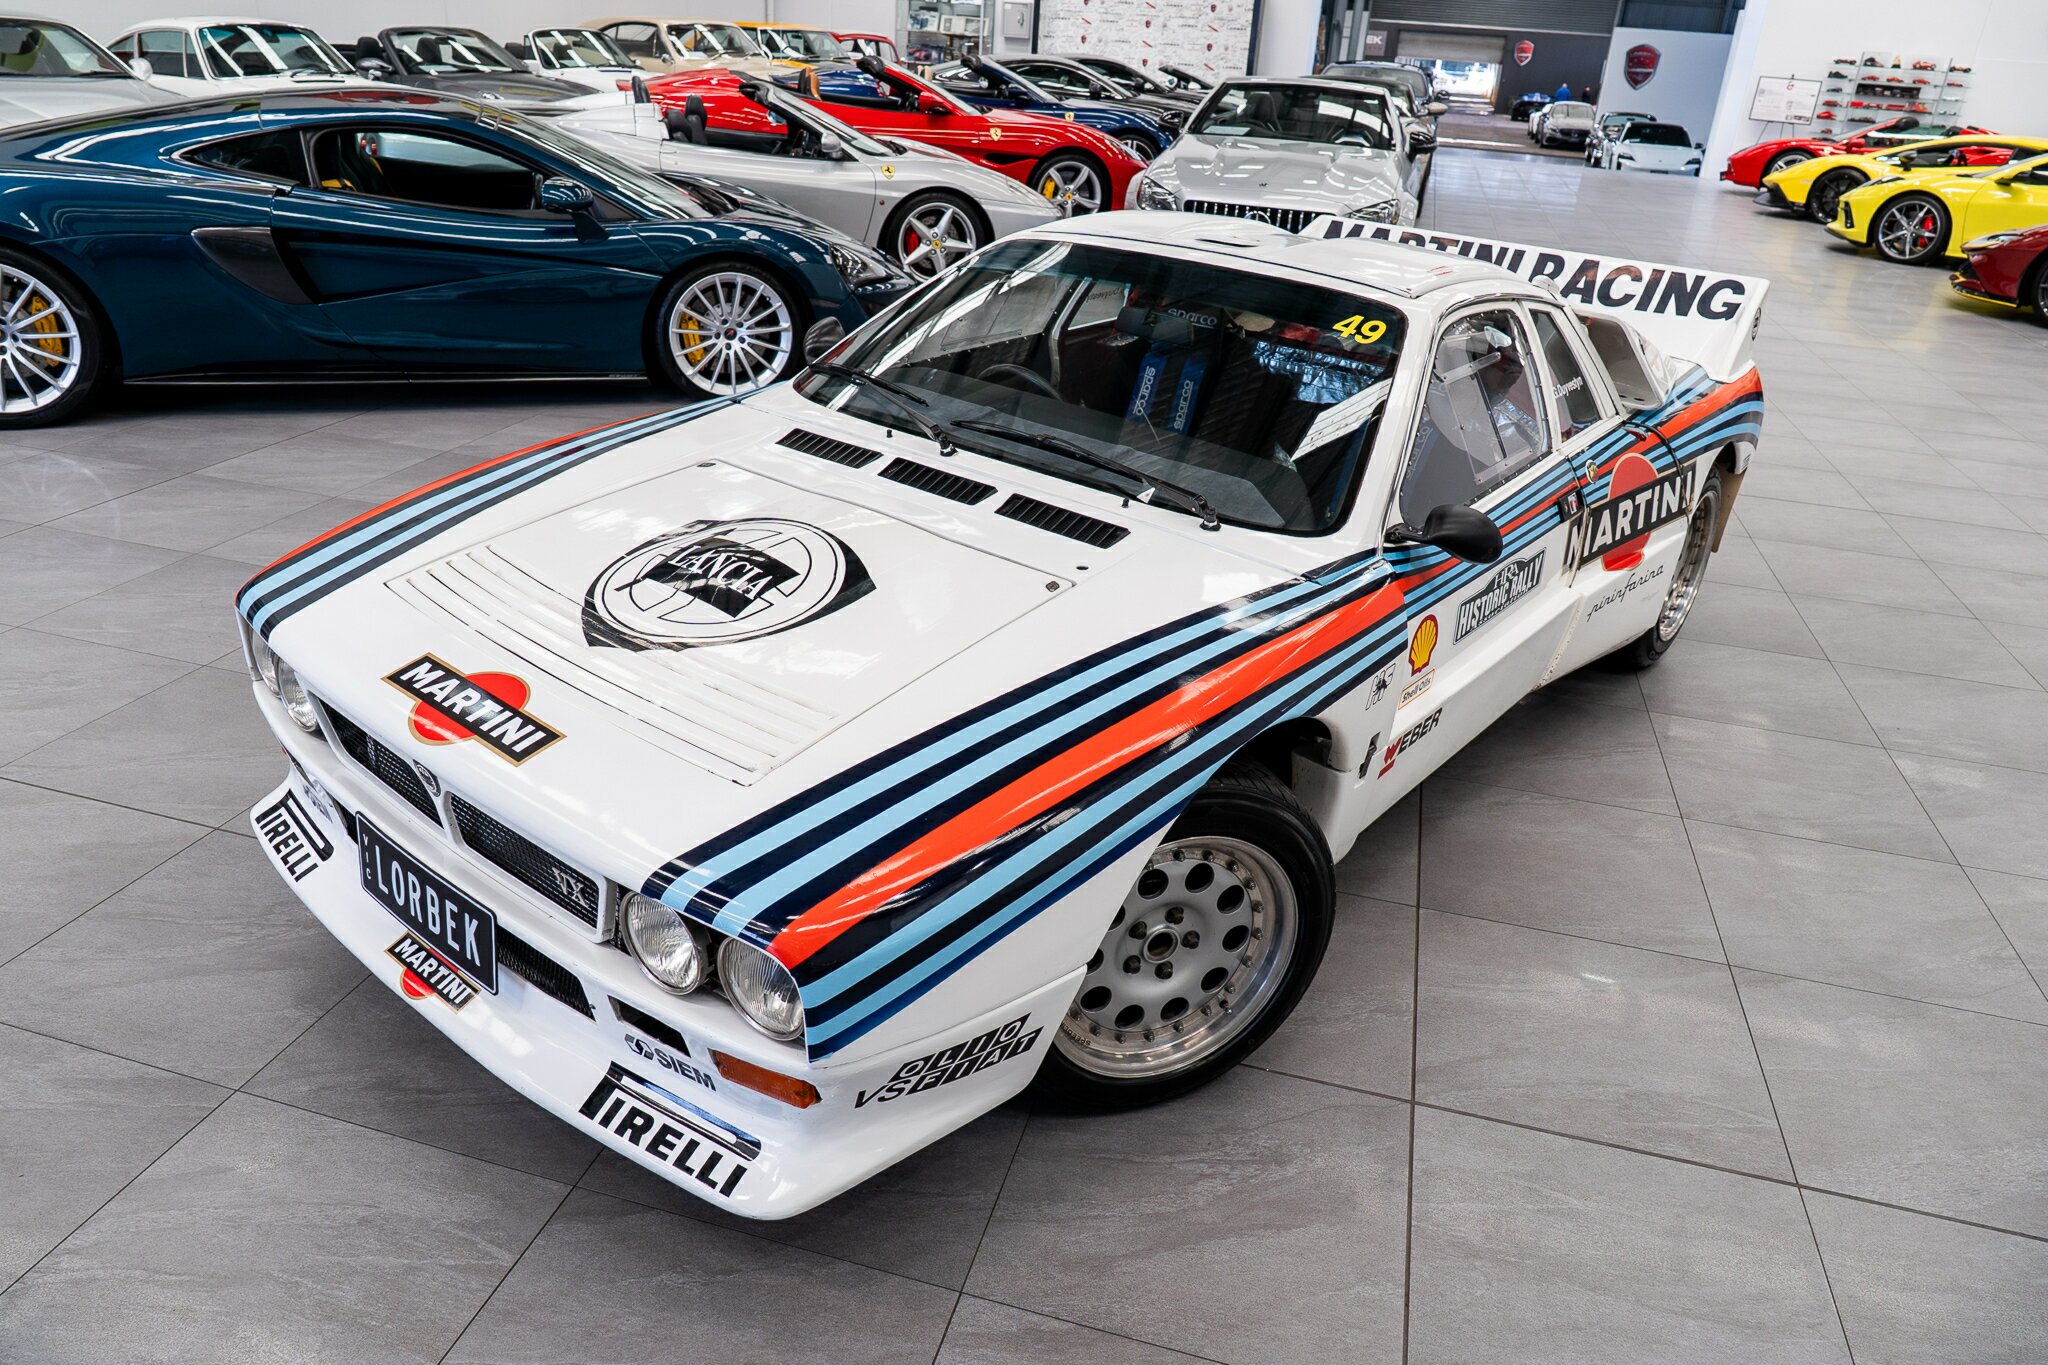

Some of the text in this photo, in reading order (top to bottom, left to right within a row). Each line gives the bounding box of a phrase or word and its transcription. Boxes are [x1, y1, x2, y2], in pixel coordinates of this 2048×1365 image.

[1528, 253, 1746, 321] RACING
[1332, 314, 1387, 345] 49
[1134, 366, 1156, 416] sparco
[1174, 380, 1193, 430] sparco
[1567, 470, 1693, 568] MARTINI
[668, 545, 773, 600] LANCIA
[1457, 583, 1509, 640] HISTORIC
[1510, 552, 1543, 599] RALLY
[399, 662, 548, 753] MARTINI
[1382, 707, 1443, 768] WEBER
[255, 788, 334, 883] PIRELLI
[363, 833, 371, 880] VIC
[375, 845, 481, 967] LORBEK
[394, 937, 468, 1004] MARTINI
[653, 1048, 717, 1092] SIEM
[892, 1015, 1028, 1081] OLIO
[909, 1029, 1041, 1093] FIAT
[578, 1061, 762, 1198] PIRELLI
